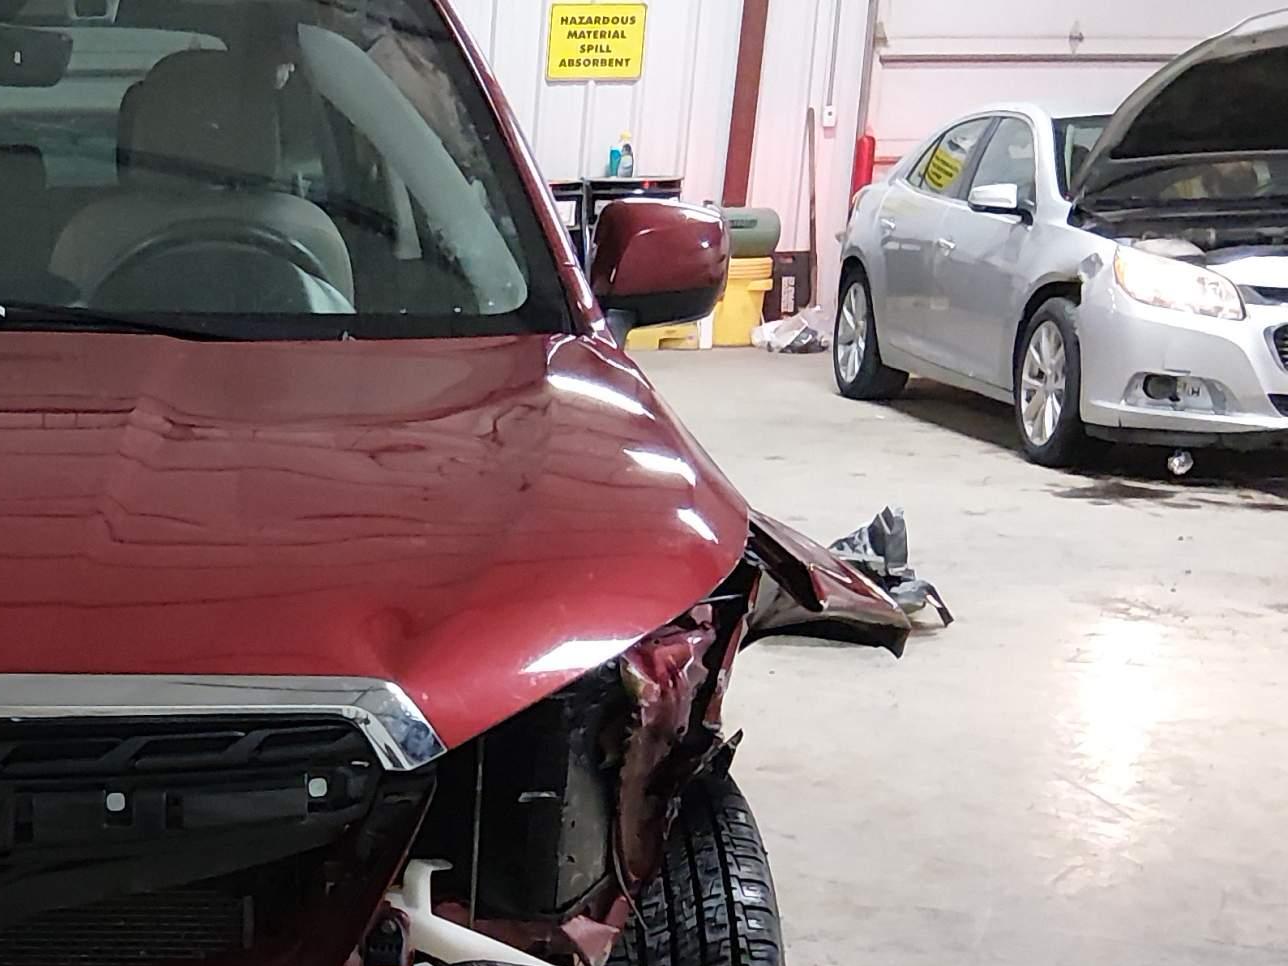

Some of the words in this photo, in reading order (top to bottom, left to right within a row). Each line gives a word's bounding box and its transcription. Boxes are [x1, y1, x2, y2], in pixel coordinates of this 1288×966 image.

[560, 16, 636, 25] HAZARDOUS
[567, 30, 627, 39] MATERIAL
[579, 44, 612, 53] SPILL
[559, 58, 630, 67] ABSORBENT
